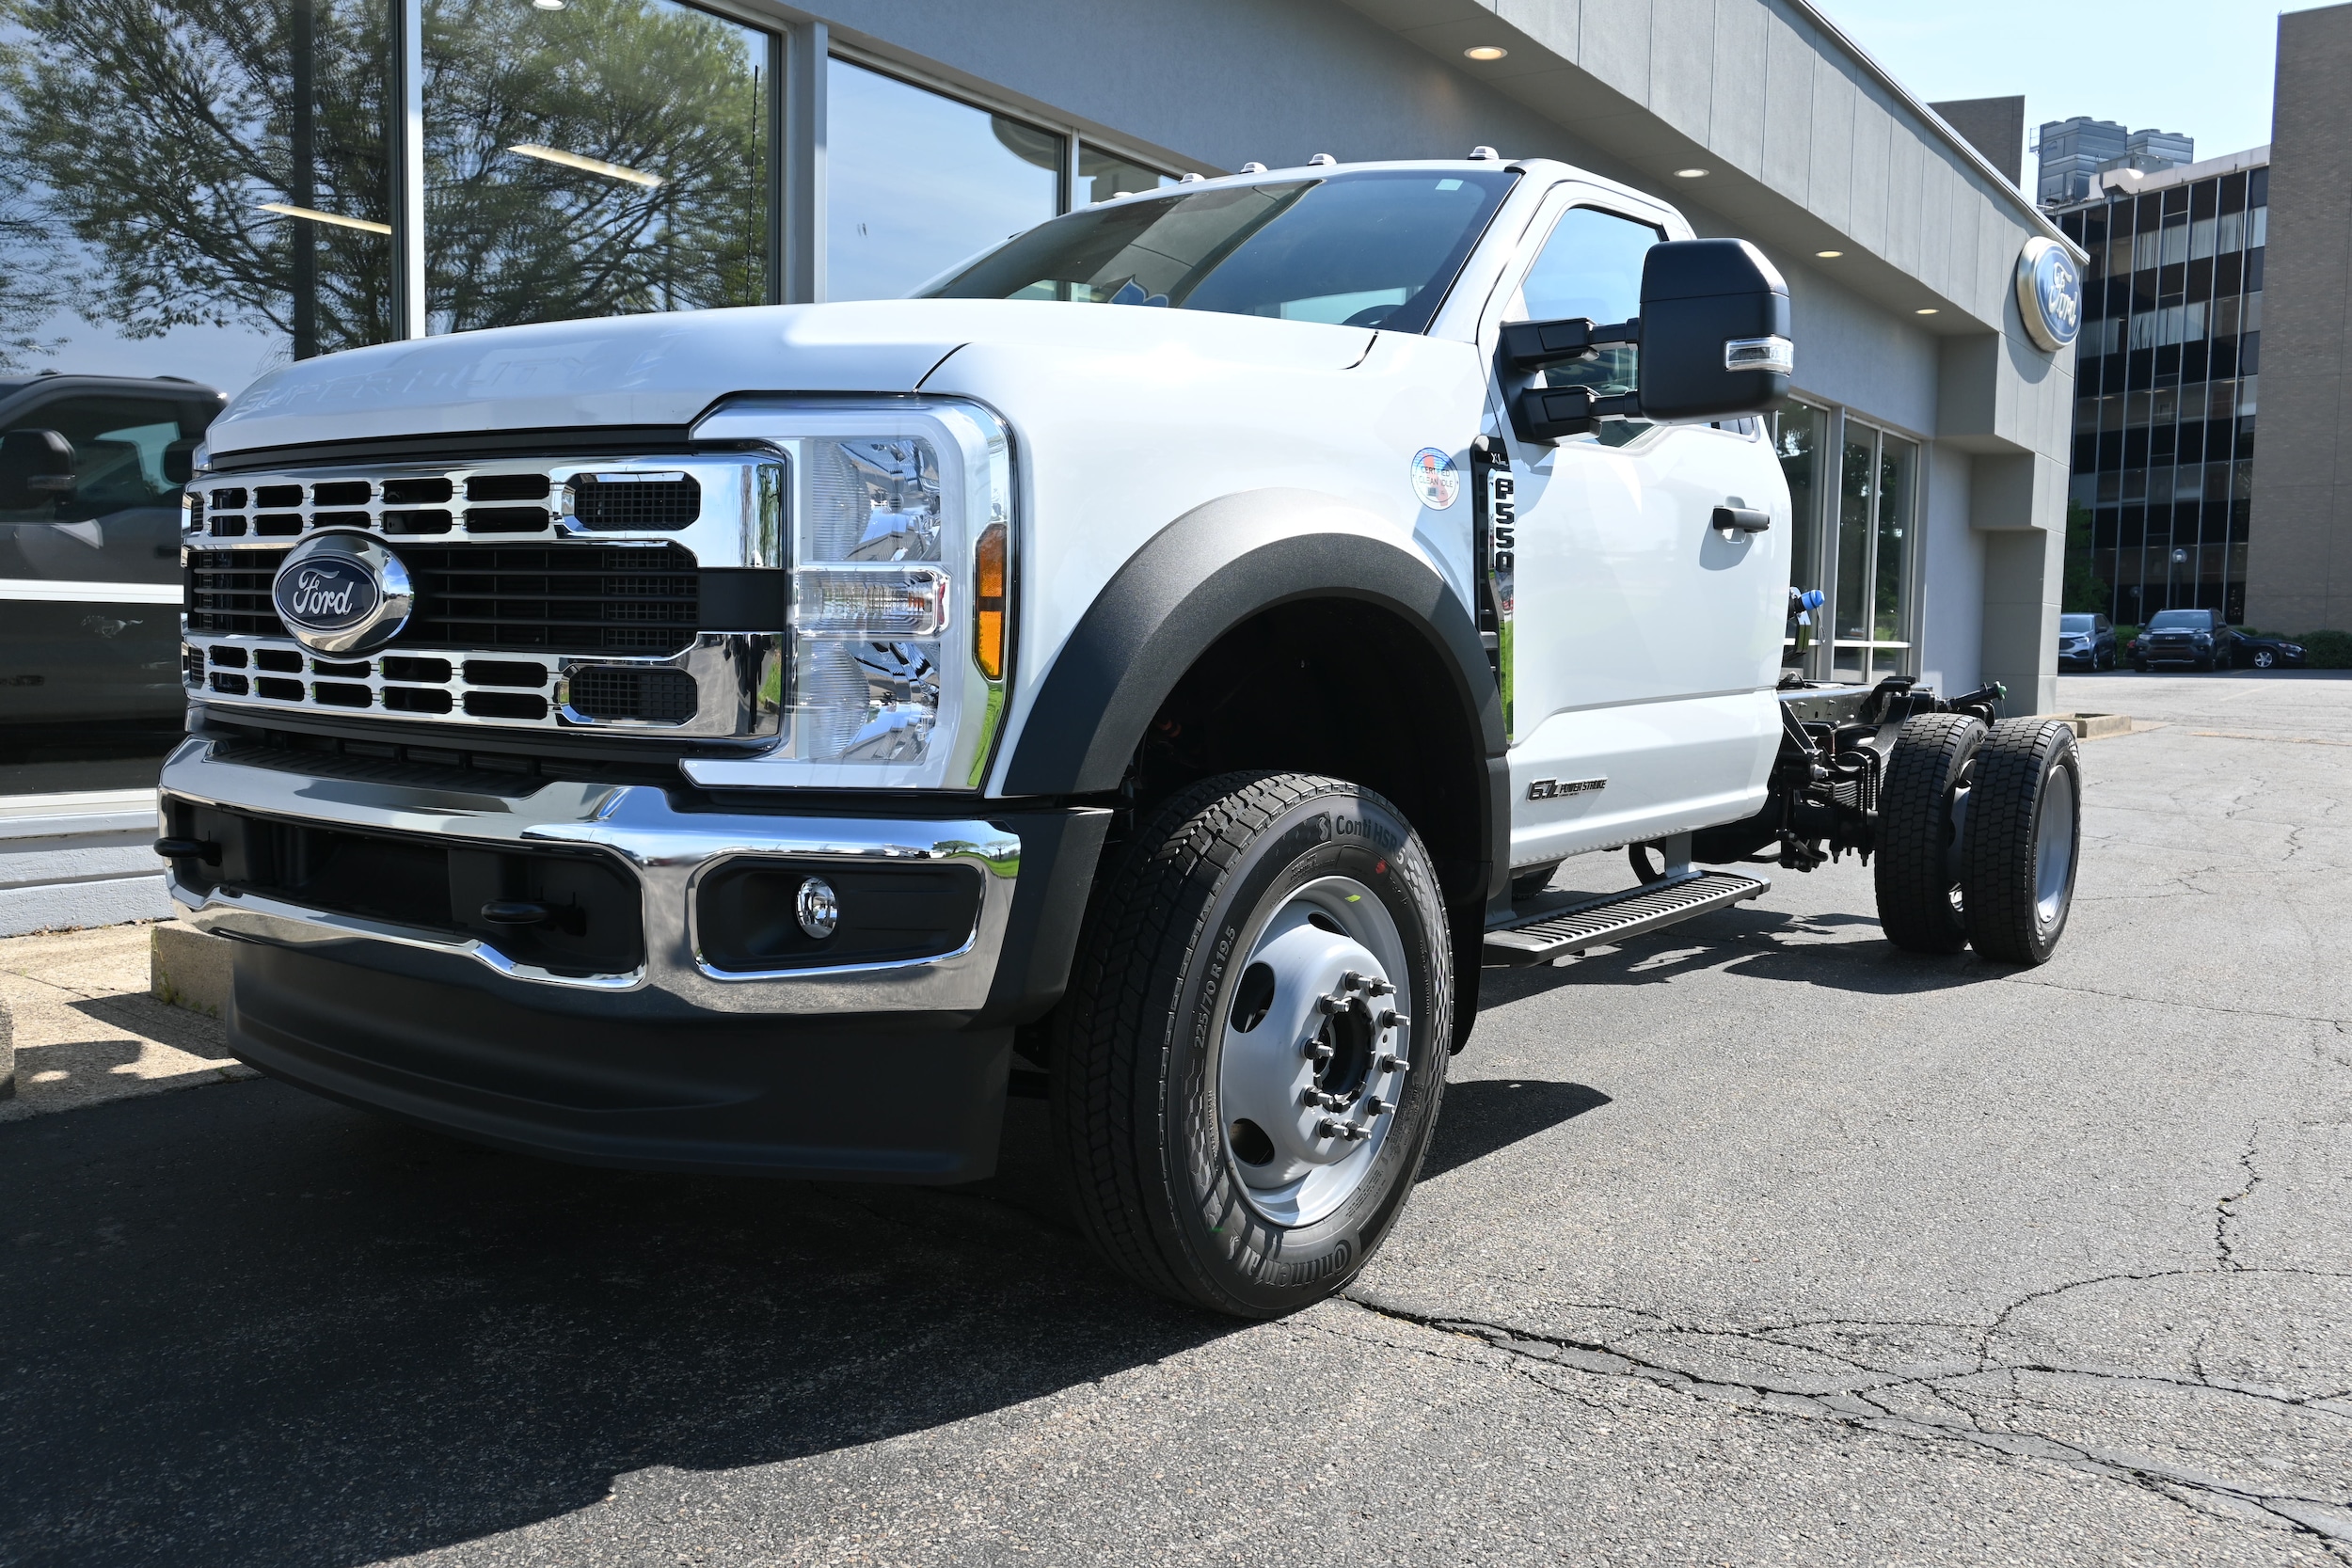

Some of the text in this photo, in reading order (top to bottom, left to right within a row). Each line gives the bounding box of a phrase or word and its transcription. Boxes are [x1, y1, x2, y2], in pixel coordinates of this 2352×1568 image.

[2048, 261, 2078, 327] Ford
[1490, 451, 1509, 467] XL
[1419, 475, 1438, 485] CLEAN
[1421, 466, 1450, 478] CERTFED
[293, 568, 355, 616] Ford
[1560, 782, 1581, 794] POWER
[1336, 815, 1372, 839] Conti
[1194, 926, 1236, 1049] 225/70 R 19.5
